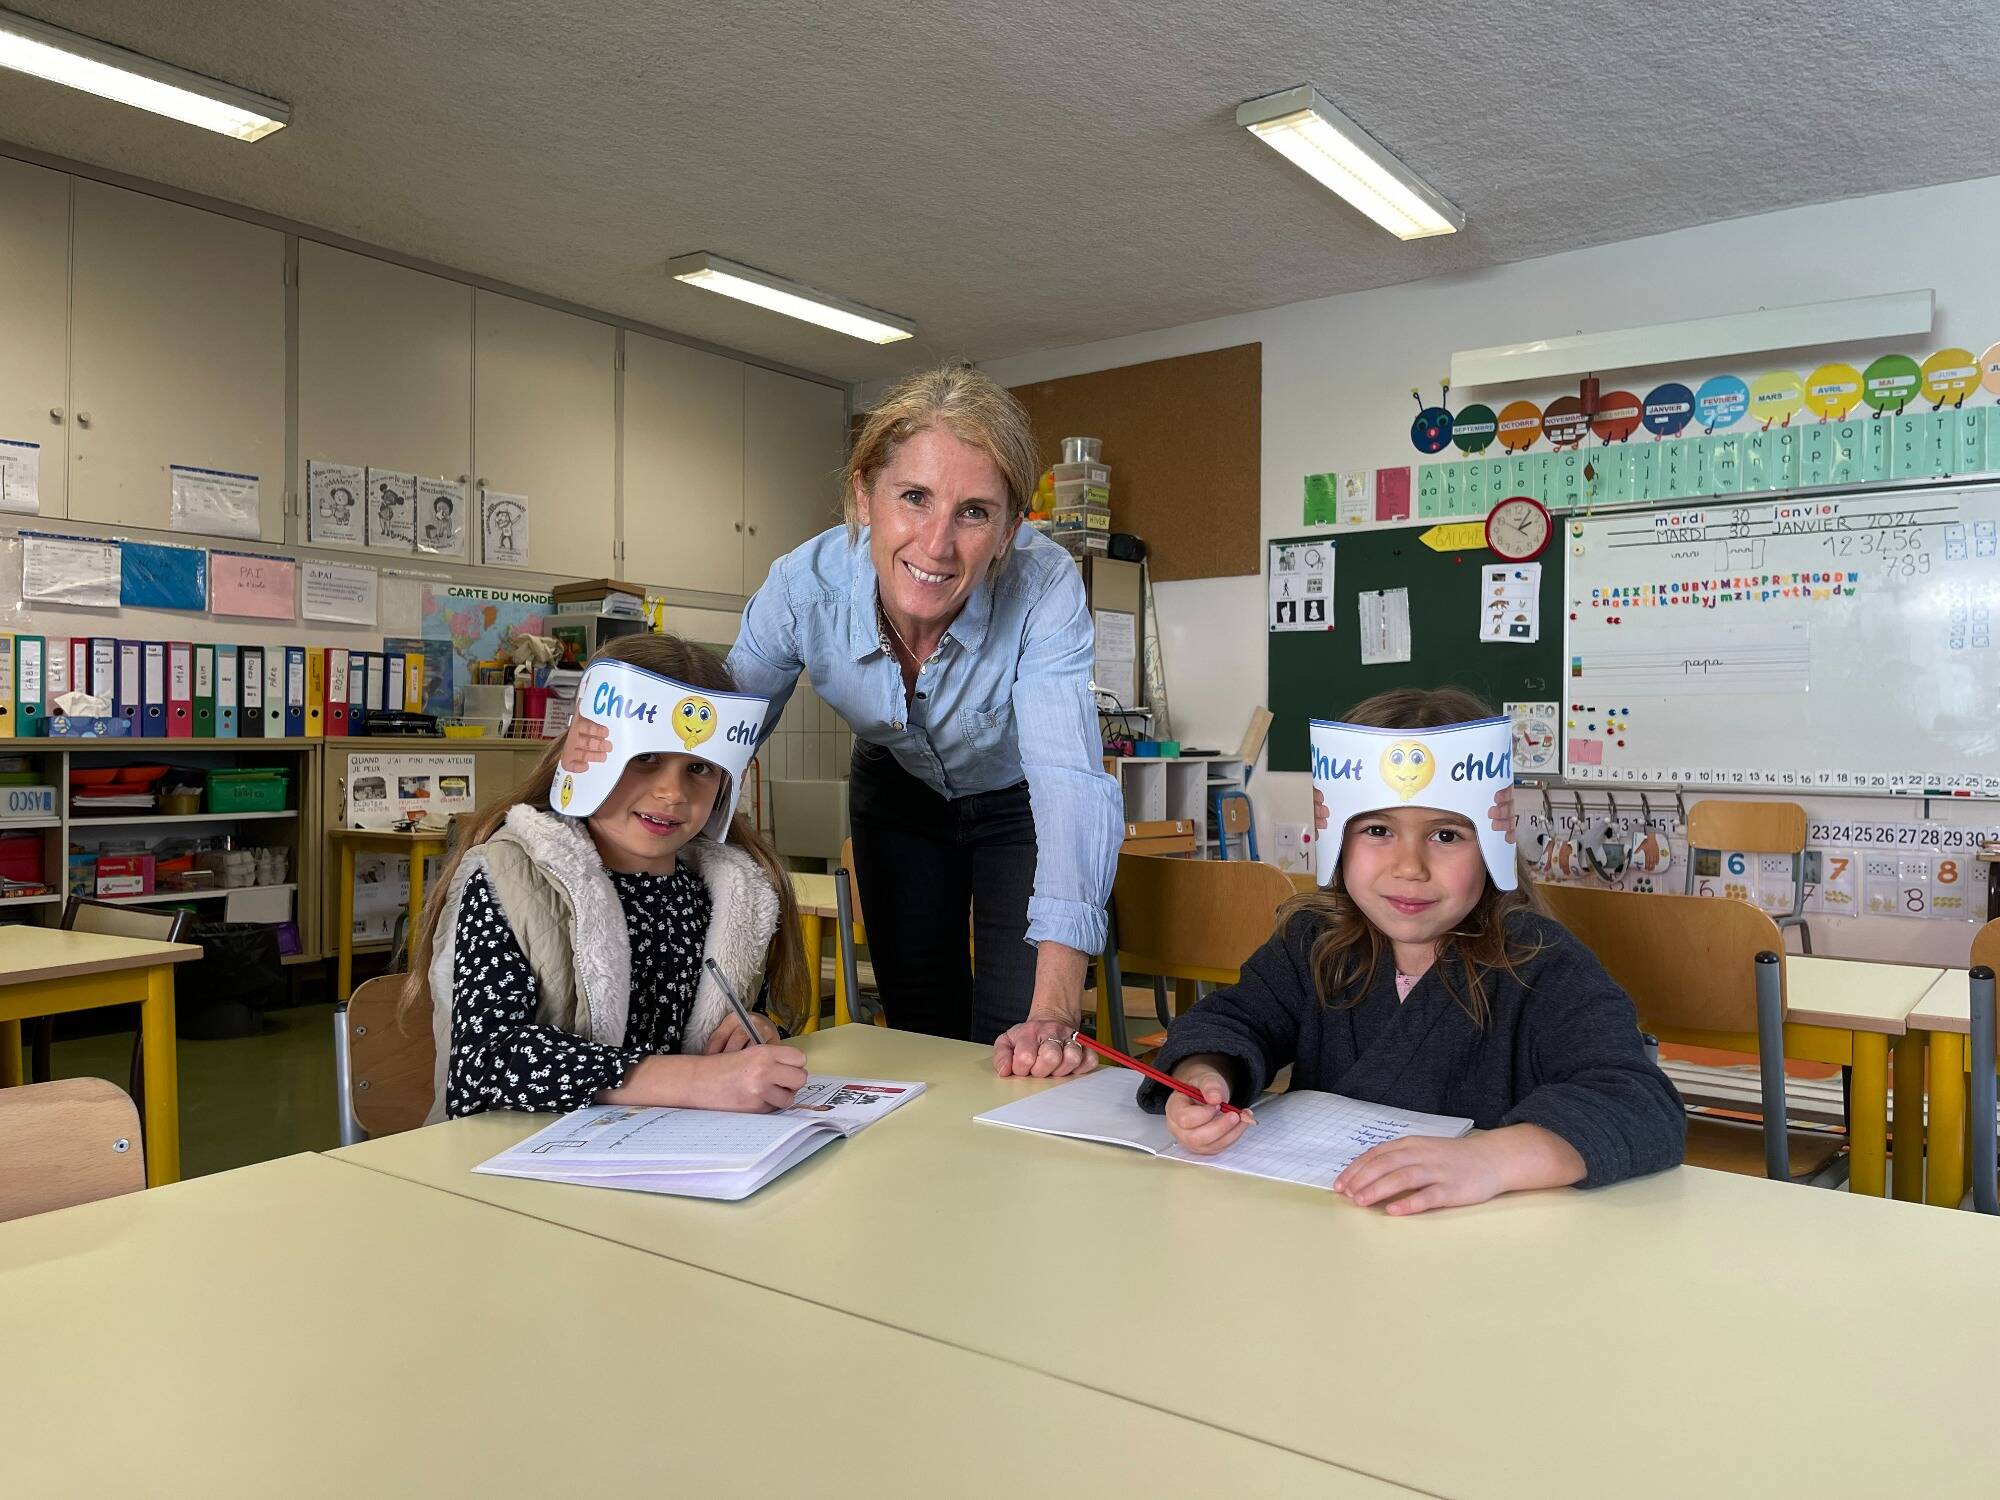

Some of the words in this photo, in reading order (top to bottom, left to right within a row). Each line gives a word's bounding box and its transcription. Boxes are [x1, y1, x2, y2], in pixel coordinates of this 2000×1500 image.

[1817, 385, 1843, 394] AVRIL
[1878, 379, 1895, 387] MAI
[1758, 393, 1783, 402] MARS
[1648, 405, 1683, 414] JANVIER
[1453, 424, 1494, 434] SEPTEMBRE
[1501, 420, 1535, 429] OCTOBRE
[1426, 471, 1432, 480] A
[1449, 469, 1454, 477] B
[1471, 467, 1478, 475] C
[1494, 465, 1501, 474] D
[1519, 462, 1523, 471] E
[1543, 459, 1548, 468] F
[1566, 457, 1574, 466] G
[1593, 454, 1599, 463] H
[1644, 449, 1650, 459] J
[1671, 447, 1677, 456] K
[1724, 441, 1734, 450] M
[1753, 439, 1761, 448] N
[1781, 435, 1792, 445] O
[1814, 431, 1820, 440] P
[1874, 425, 1881, 435] R
[1906, 422, 1912, 432] S
[1936, 418, 1944, 430] T
[1967, 416, 1975, 426] U
[1421, 488, 1428, 496] a
[1448, 483, 1455, 493] b
[1471, 484, 1477, 492] c
[1494, 480, 1501, 490] d
[1566, 475, 1573, 486] g
[1671, 463, 1676, 473] k
[1754, 459, 1760, 467] n
[1782, 455, 1790, 463] o
[1812, 451, 1821, 462] p
[1842, 448, 1851, 460] q
[1876, 446, 1880, 454] r
[1906, 443, 1911, 451] s
[1937, 438, 1941, 449] t
[1967, 437, 1975, 445] u
[1655, 513, 1704, 527] mardi
[1732, 509, 1750, 523] 30
[1773, 503, 1839, 520] janvier
[1656, 527, 1706, 543] MARDI
[1729, 525, 1750, 538] 30
[1772, 517, 1852, 535] JANVIER
[240, 566, 263, 578] PAI
[317, 570, 333, 580] PAI
[447, 587, 489, 600] CARTE
[491, 590, 509, 602] DU
[512, 592, 555, 605] MONDE
[1681, 658, 1724, 675] papa
[335, 667, 344, 691] ROSE
[593, 681, 658, 724] Chut
[351, 757, 380, 765] QUAND
[429, 757, 445, 765] MON
[352, 765, 361, 773] JE
[363, 765, 381, 773] PEUX
[1583, 769, 1588, 777] 2
[1628, 771, 1633, 779] 5
[1658, 772, 1661, 780] 7
[1672, 772, 1677, 780] 8
[1700, 772, 1709, 780] 10
[1717, 773, 1725, 781] 11
[1733, 774, 1742, 782] 12
[1783, 774, 1793, 783] 15
[1837, 774, 1847, 782] 18
[1872, 777, 1884, 785] 20
[1892, 777, 1903, 785] 21
[1909, 776, 1921, 784] 22
[1928, 776, 1940, 785] 23
[1948, 777, 1959, 786] 24
[1966, 778, 1979, 786] 25
[1986, 779, 1999, 787] 26
[1812, 825, 1830, 840] 23
[1832, 826, 1851, 841] 24
[1854, 827, 1873, 842] 25
[1875, 828, 1895, 843] 26
[1898, 829, 1917, 844] 27
[1920, 830, 1940, 845] 28
[1943, 831, 1963, 846] 29
[1965, 832, 1985, 847] 30
[1727, 852, 1745, 875] 6
[1829, 858, 1849, 881] 7
[1937, 860, 1958, 884] 8
[1904, 888, 1925, 912] 8
